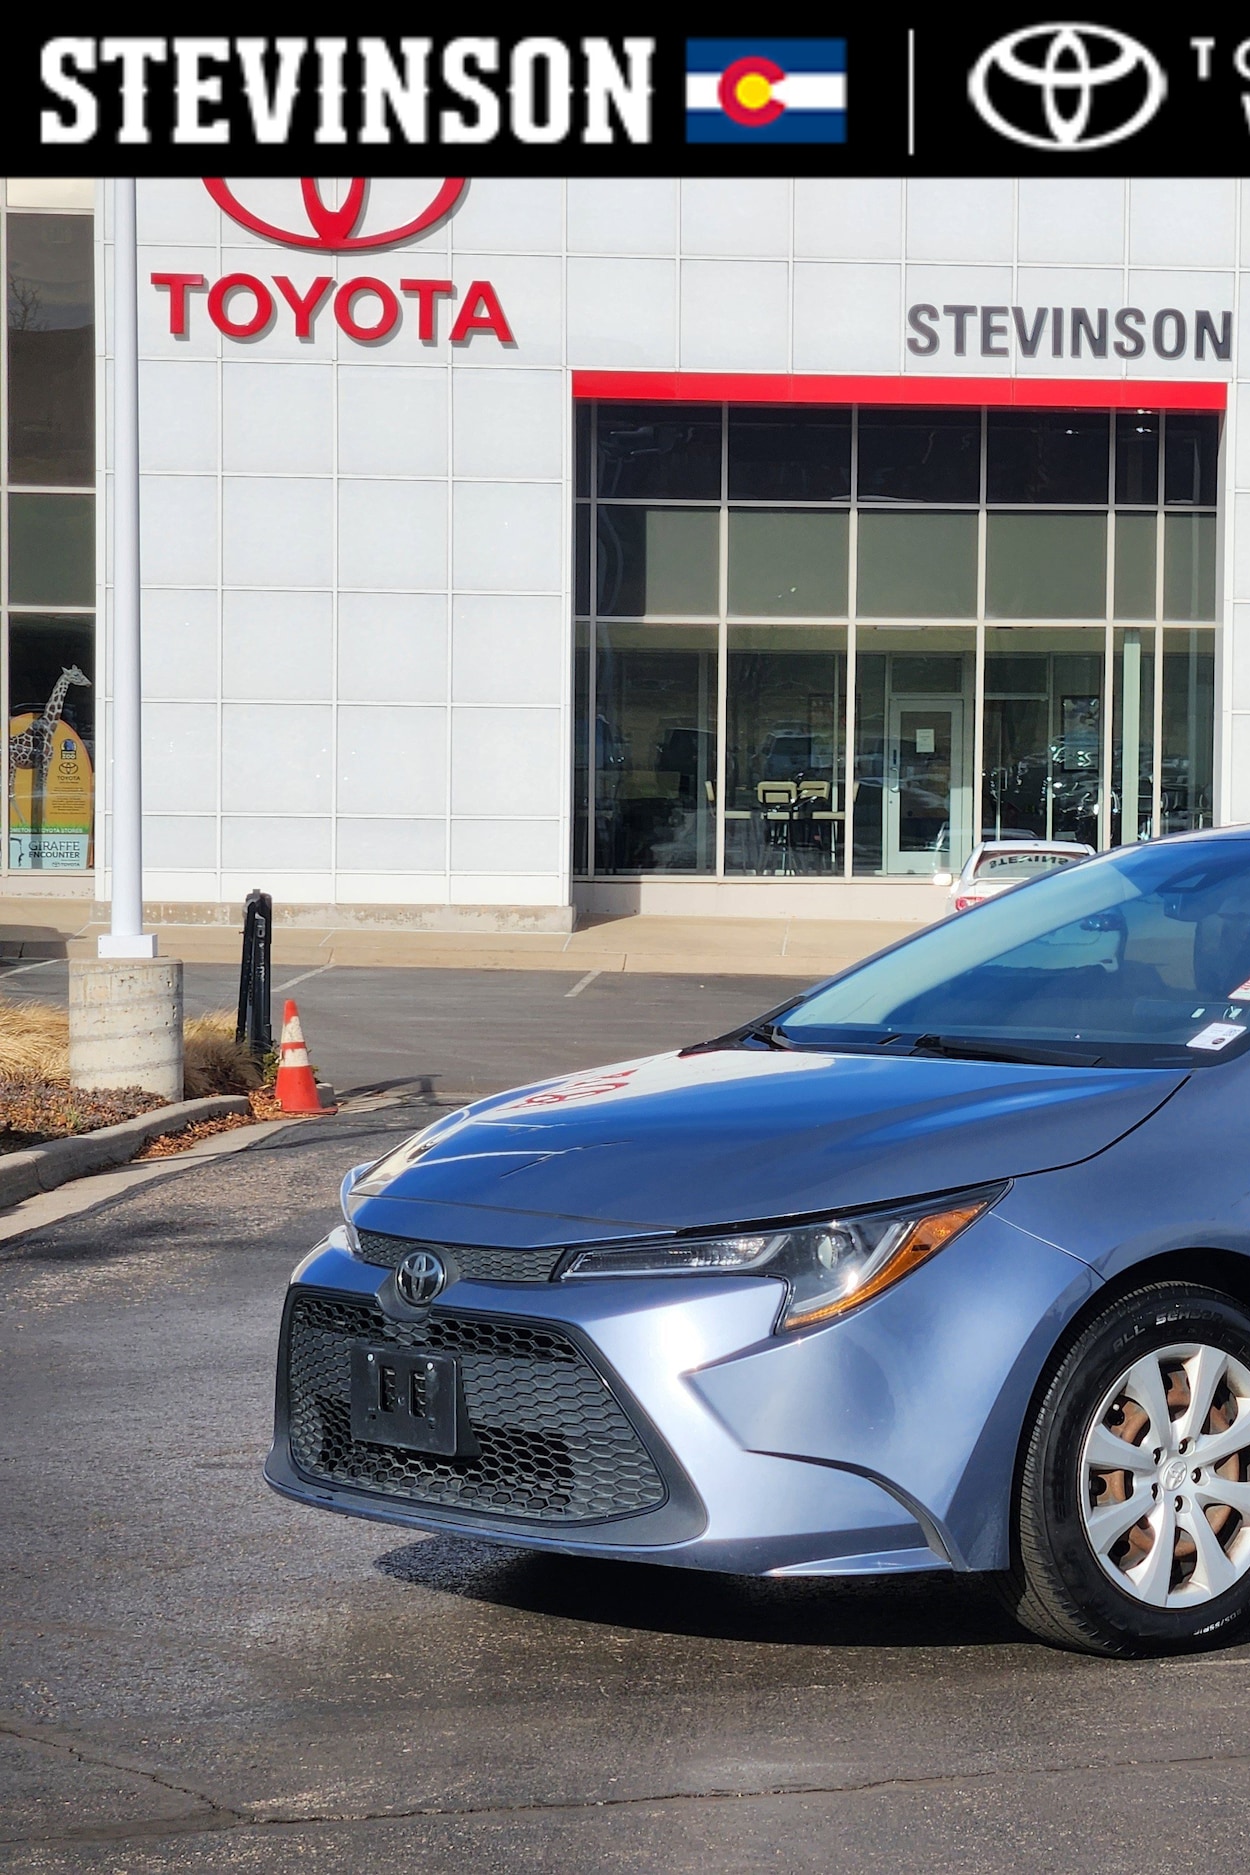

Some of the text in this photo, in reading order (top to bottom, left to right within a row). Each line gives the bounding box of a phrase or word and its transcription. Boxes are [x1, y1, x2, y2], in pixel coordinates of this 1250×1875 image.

[150, 272, 517, 345] TOYOTA
[907, 303, 1234, 362] STEVINSON
[28, 841, 80, 851] GIRAFFE
[28, 851, 80, 859] ENCOUNTER
